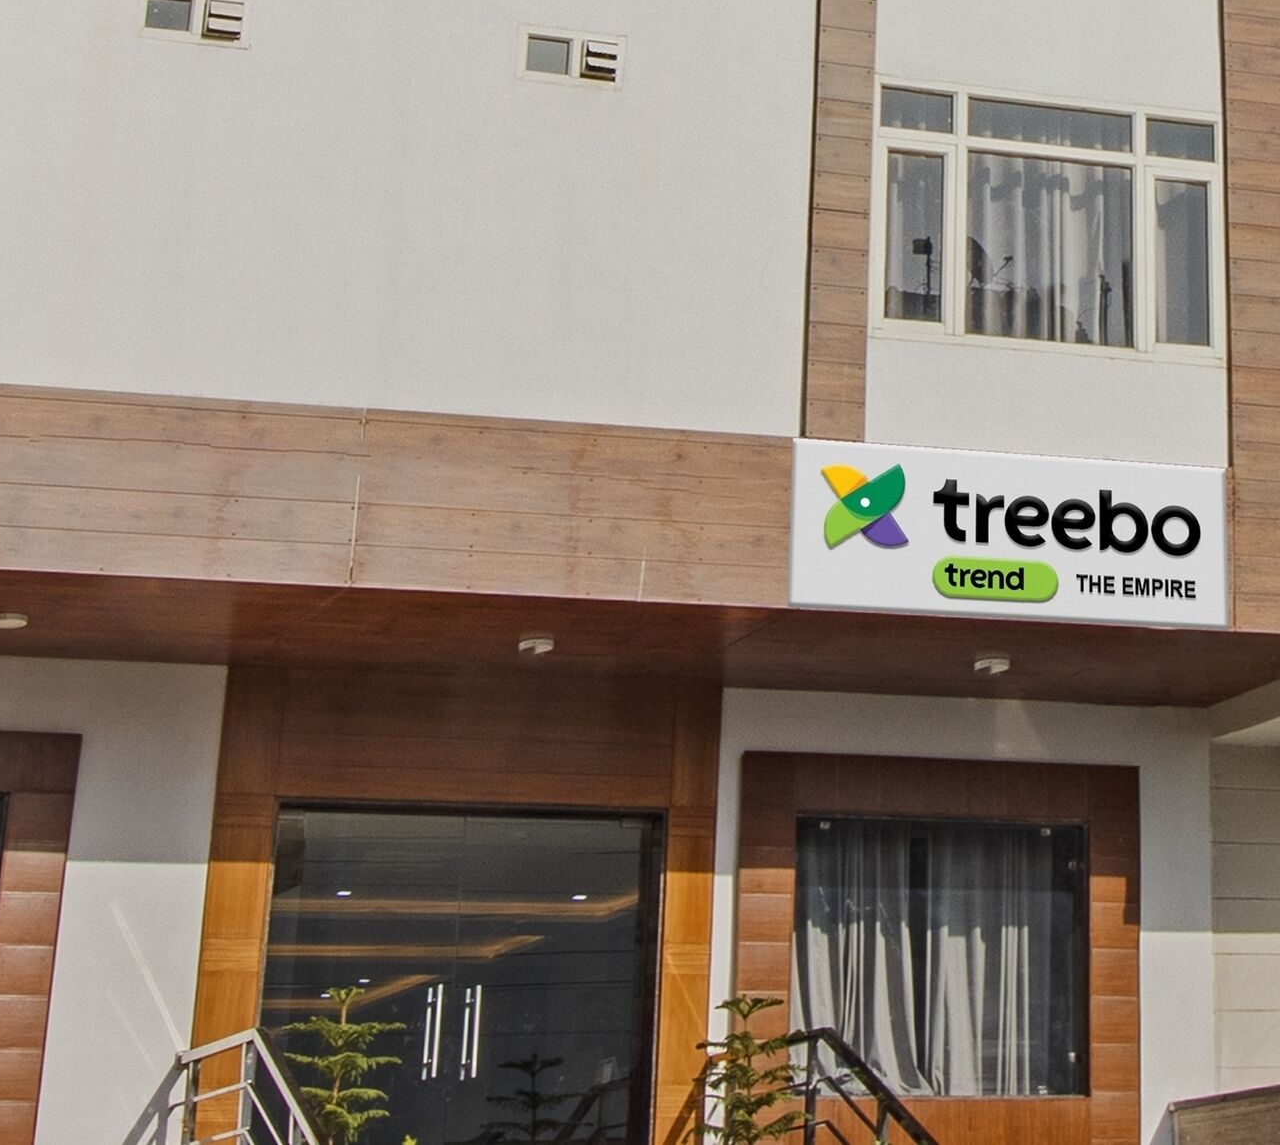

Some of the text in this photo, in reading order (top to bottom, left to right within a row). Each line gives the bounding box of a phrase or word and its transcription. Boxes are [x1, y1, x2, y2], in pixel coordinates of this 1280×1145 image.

[933, 478, 1202, 557] treebo
[944, 562, 1025, 592] trend
[1075, 573, 1197, 599] THE EMPIRE
